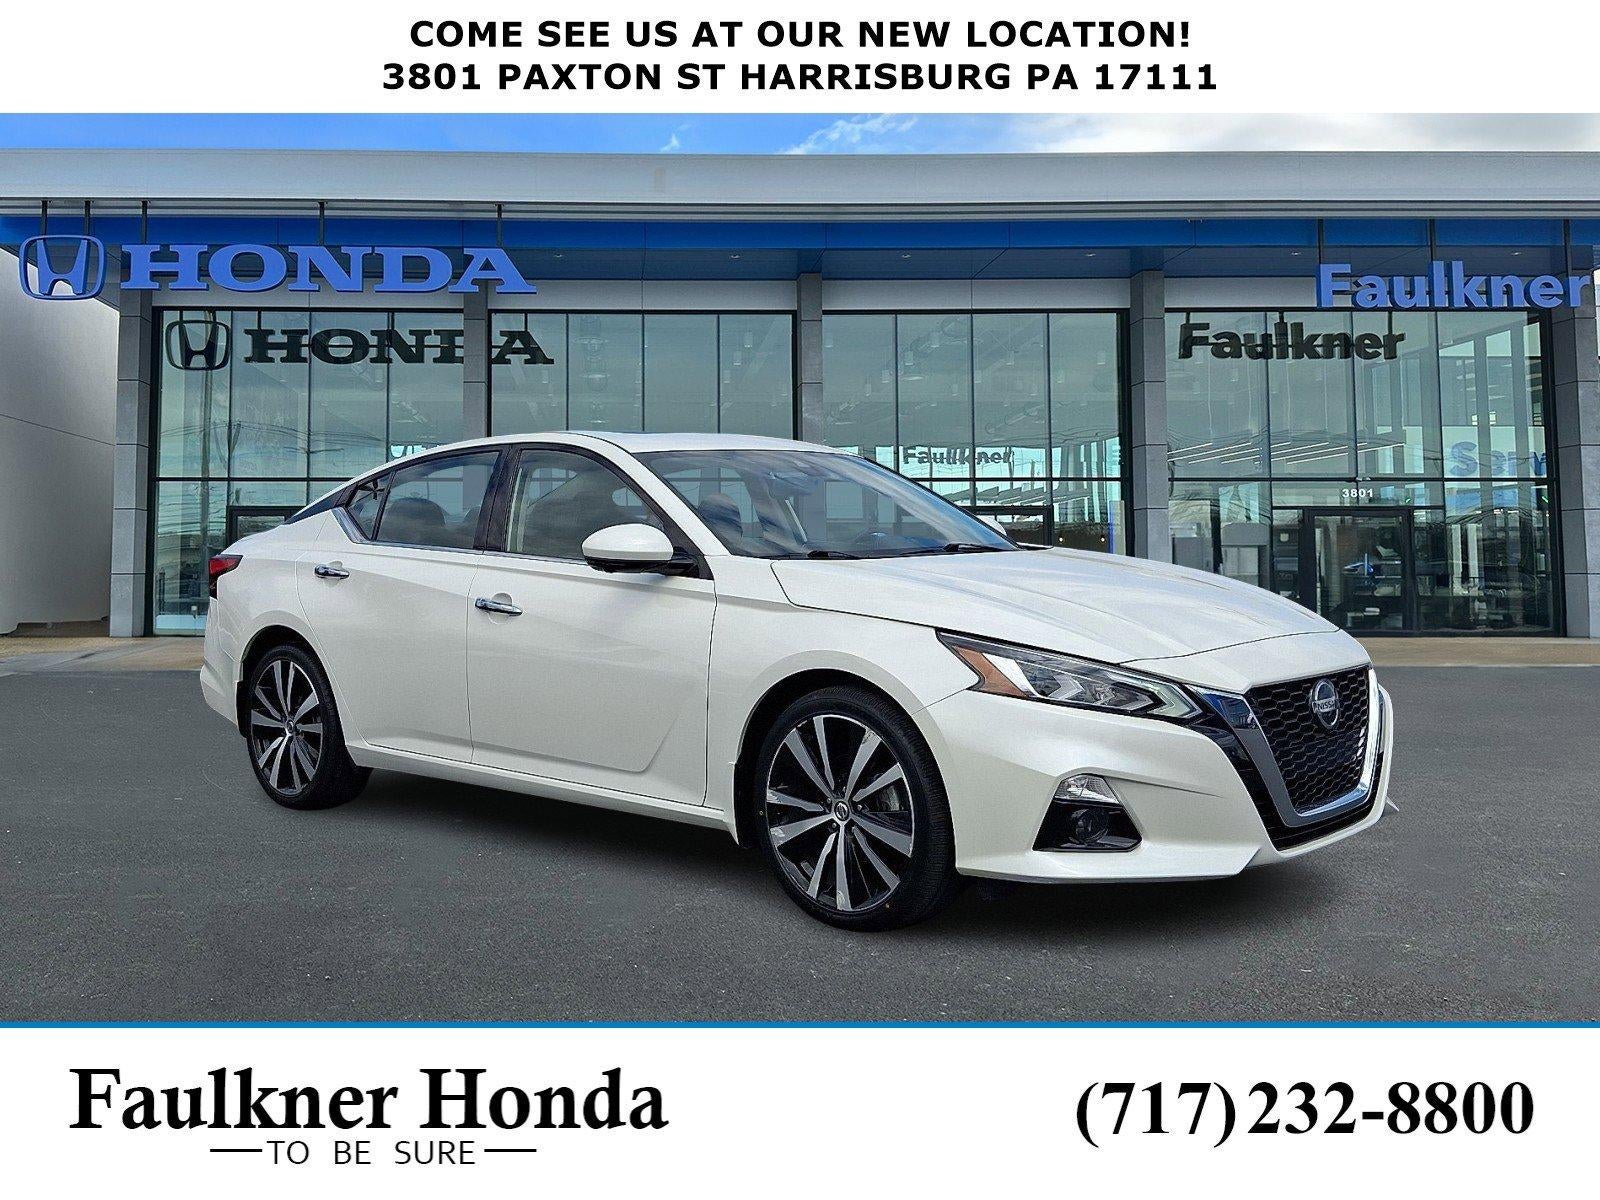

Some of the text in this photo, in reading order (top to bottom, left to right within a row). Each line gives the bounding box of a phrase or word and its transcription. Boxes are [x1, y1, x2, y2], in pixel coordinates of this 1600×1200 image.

[120, 243, 537, 294] HONDA
[1316, 260, 1591, 309] Faulkner
[1178, 321, 1406, 361] Faulkner
[1341, 488, 1374, 498] 3801
